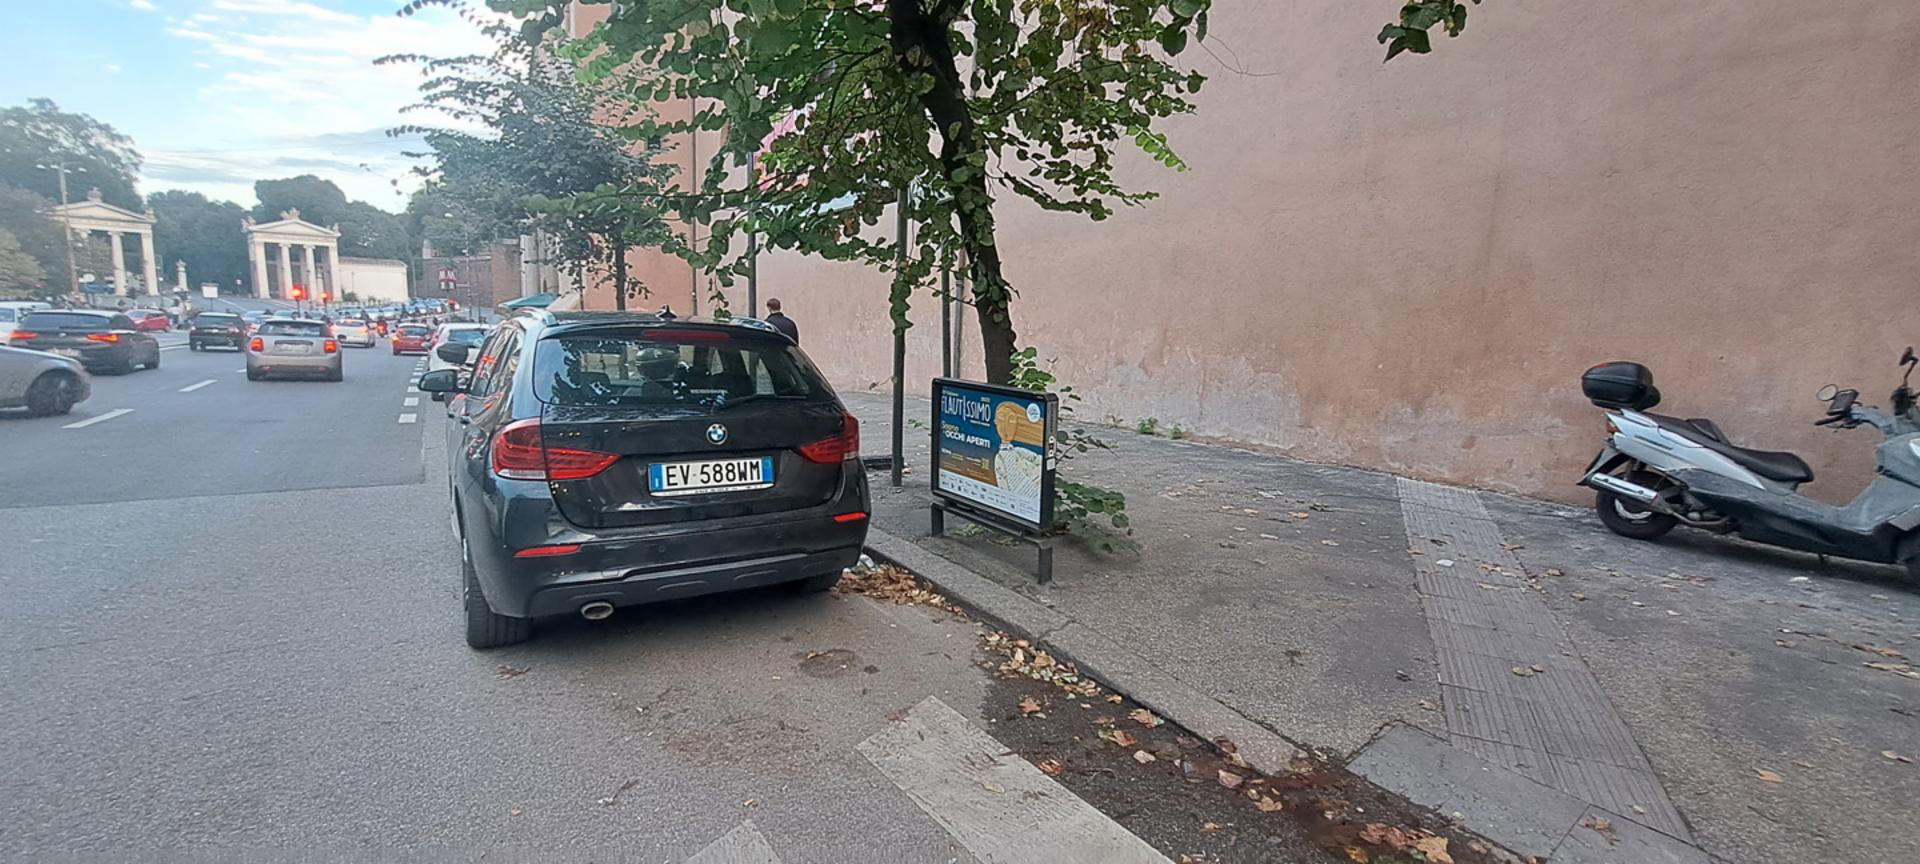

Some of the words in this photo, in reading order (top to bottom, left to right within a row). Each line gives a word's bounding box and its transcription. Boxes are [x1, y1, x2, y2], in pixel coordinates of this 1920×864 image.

[941, 395, 991, 422] FLAUTISSIMO
[945, 430, 966, 442] OCCHI
[966, 434, 991, 448] APERTI
[666, 465, 690, 487] EV
[700, 461, 761, 484] 588WM
